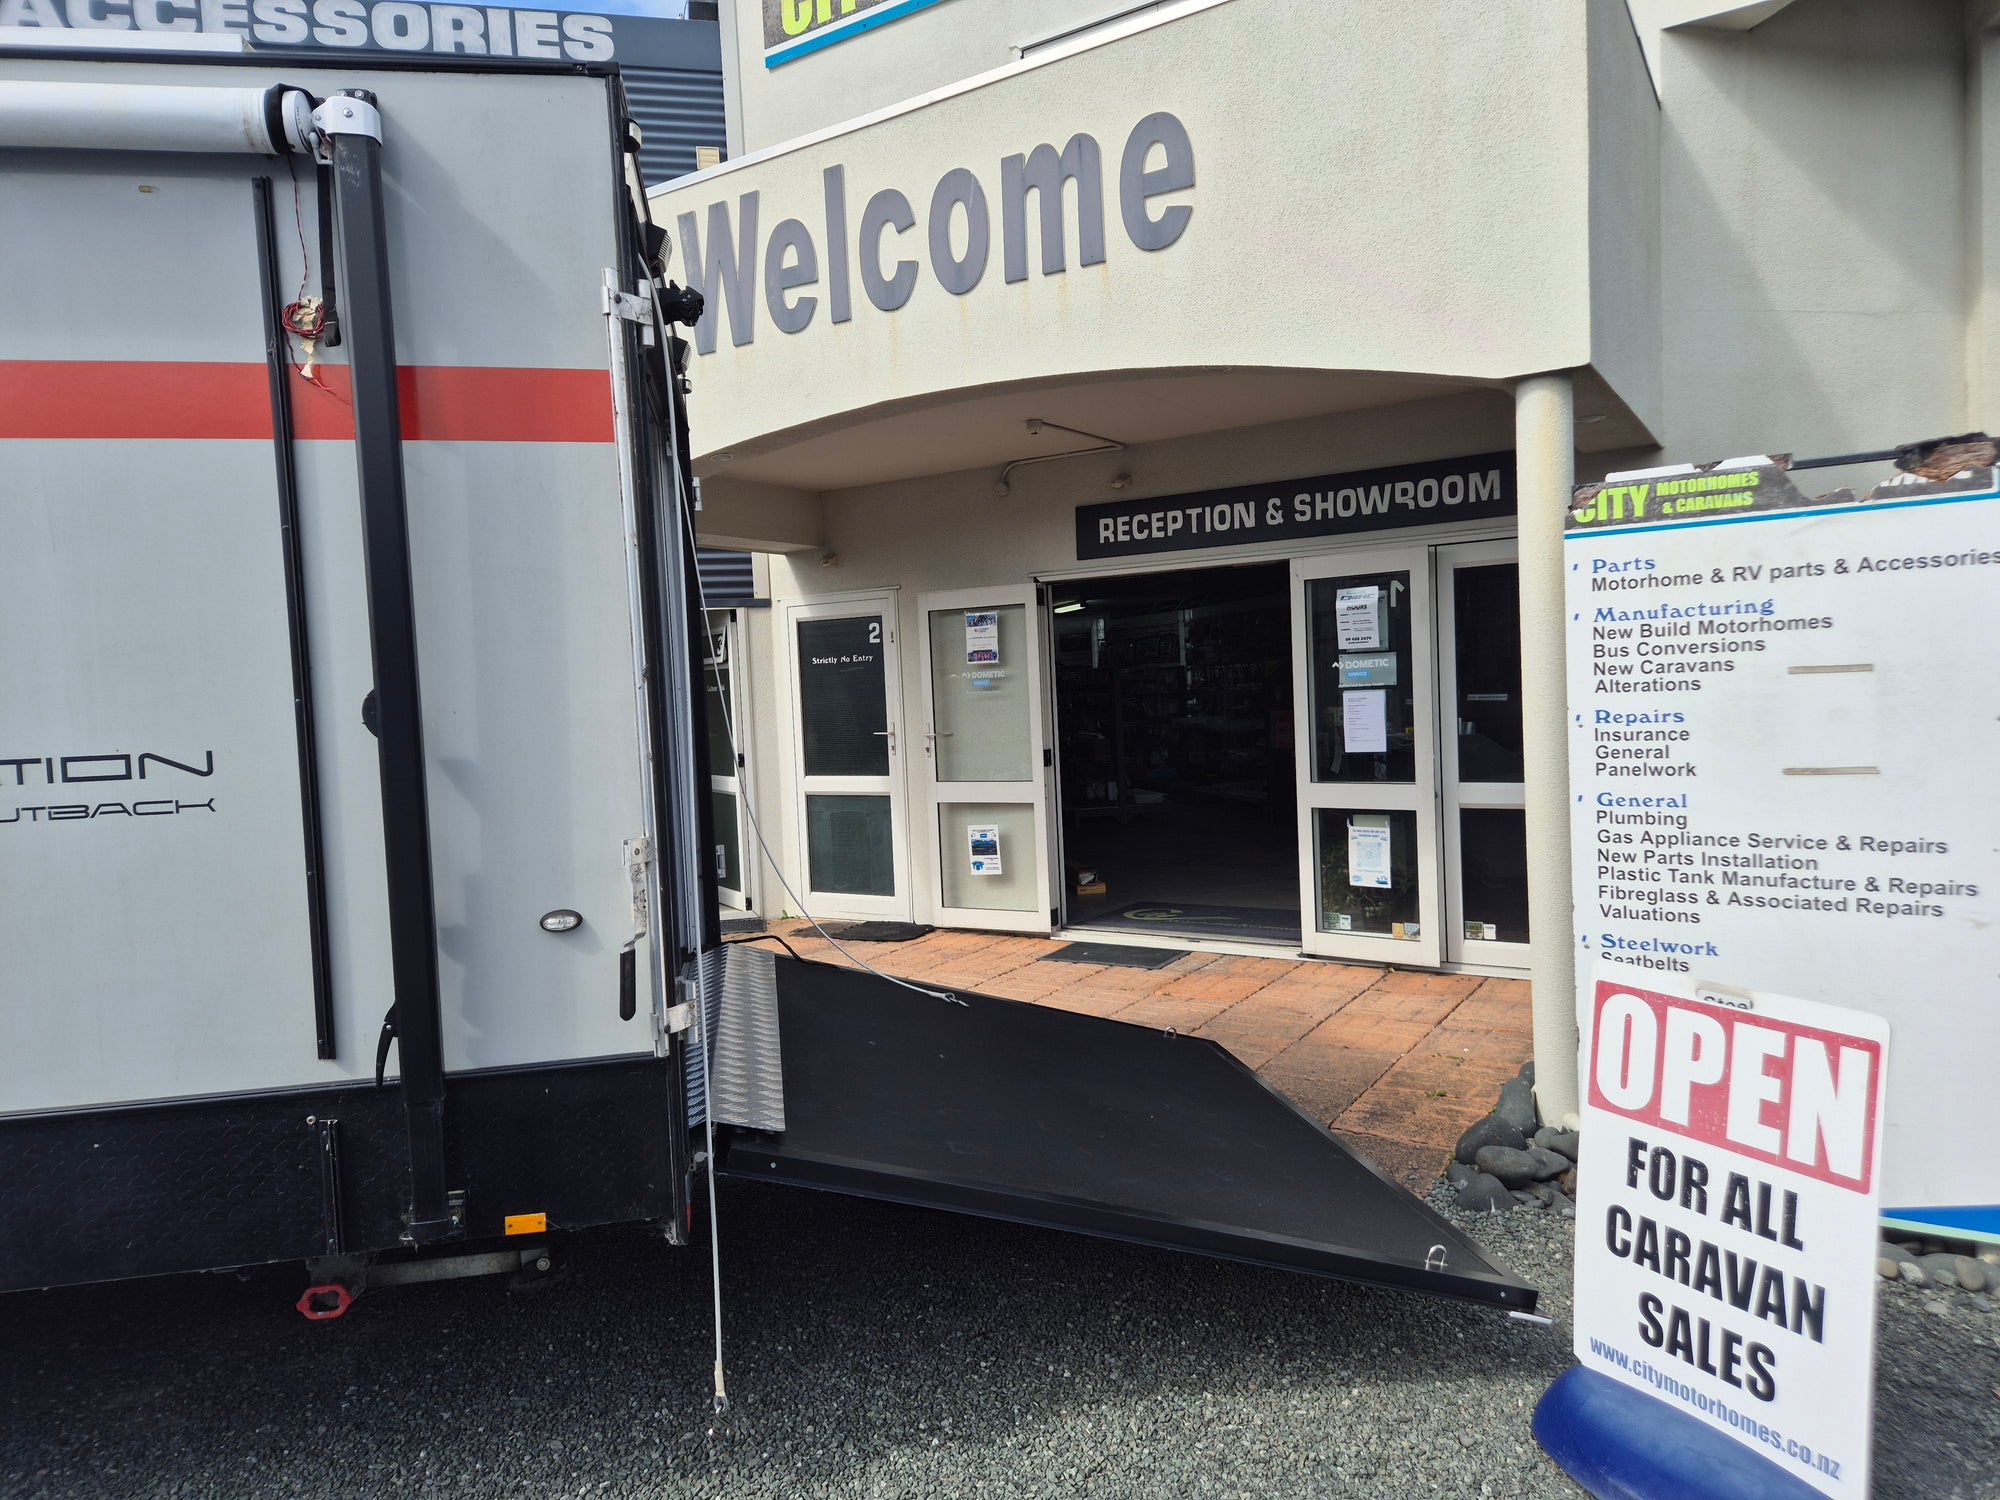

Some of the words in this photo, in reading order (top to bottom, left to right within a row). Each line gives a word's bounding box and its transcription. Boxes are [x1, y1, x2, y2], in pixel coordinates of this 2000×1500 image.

[2, 0, 614, 61] ACCESSORIES
[677, 111, 1195, 356] Welcome
[1099, 501, 1256, 543] RECEPTION
[1266, 497, 1284, 526] &
[1294, 469, 1501, 521] SHOWROOM
[1574, 484, 1650, 523] CITY
[1656, 471, 1760, 496] MOTORHOMES
[1662, 502, 1673, 514] &
[1676, 491, 1754, 513] CARAVANS
[1591, 569, 1703, 592] Motorhome
[1710, 568, 1725, 584] &
[1733, 565, 1763, 581] RV
[1770, 562, 1824, 584] parts
[1834, 558, 1849, 574] &
[1857, 548, 2000, 572] Accessories
[1592, 556, 1656, 574] Parts
[1593, 598, 1775, 623] Manufacturing
[868, 622, 880, 643] 2
[1592, 626, 1633, 641] New
[1640, 621, 1691, 638] Build
[1699, 615, 1833, 635] Motorhomes
[812, 656, 838, 665] Strictly
[853, 654, 873, 662] Entry
[1593, 643, 1630, 659] Bus
[1636, 638, 1766, 657] Conversions
[971, 670, 1005, 678] DOMETIC
[1345, 658, 1389, 669] DOMETIC
[1593, 661, 1634, 677] New
[1640, 658, 1735, 675] Caravans
[1594, 677, 1701, 694] Alterations
[1595, 709, 1685, 725] Repairs
[1594, 728, 1690, 742] Insurance
[1596, 745, 1670, 760] General
[1596, 762, 1696, 777] Panelwork
[1596, 792, 1687, 808] General
[1596, 810, 1688, 830] Plumbing
[1597, 829, 1634, 845] Gas
[1640, 831, 1740, 852] Appliance
[1747, 834, 1827, 851] Service
[1835, 836, 1851, 852] &
[1859, 837, 1948, 856] Repairs
[1598, 849, 1636, 864] New
[1644, 850, 1694, 866] Parts
[1701, 852, 1818, 871] Installation
[1598, 866, 1661, 884] Plastic
[1668, 869, 1714, 885] Tank
[1722, 872, 1856, 892] Manufacture
[1864, 877, 1880, 892] &
[1888, 878, 1979, 898] Repairs
[1598, 885, 1698, 906] Fibreglass
[1706, 890, 1721, 905] &
[1727, 892, 1848, 913] Associated
[1855, 898, 1944, 917] Repairs
[1600, 904, 1701, 924] Valuations
[1601, 933, 1720, 957] Steelwork
[1596, 993, 1872, 1181] OPEN
[1627, 1135, 1709, 1215] FOR
[1721, 1170, 1804, 1251] ALL
[1605, 1203, 1826, 1344] CARAVAN
[1638, 1291, 1776, 1403] SALES
[1589, 1335, 1841, 1480] www.citymotorhomes.co.nz
